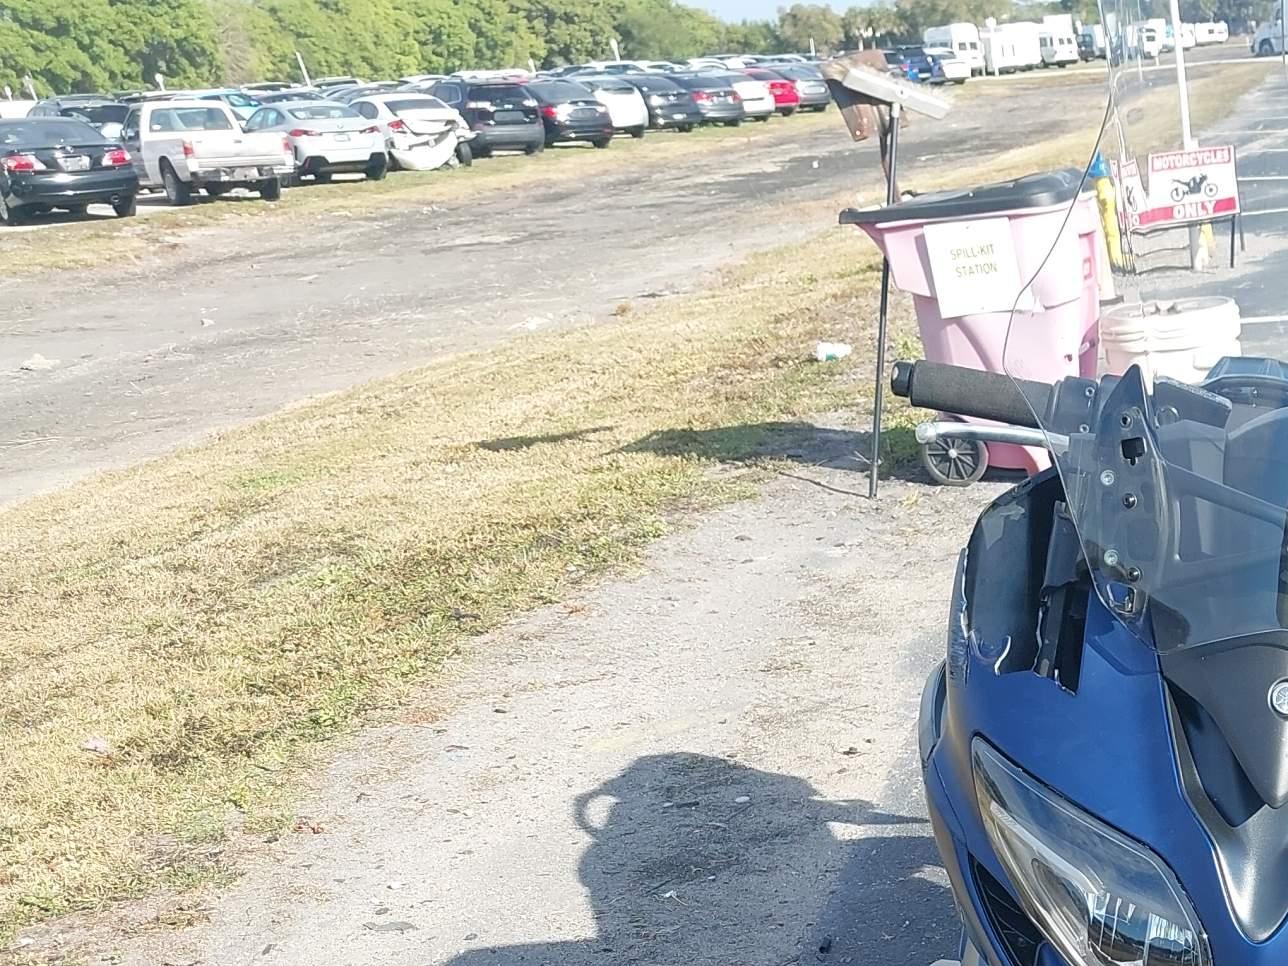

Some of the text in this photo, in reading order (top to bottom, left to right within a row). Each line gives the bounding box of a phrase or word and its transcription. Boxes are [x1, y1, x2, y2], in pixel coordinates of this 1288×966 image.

[1151, 149, 1230, 170] MOTORCYCLES
[1172, 199, 1217, 219] ONLY
[955, 262, 998, 278] STATION
